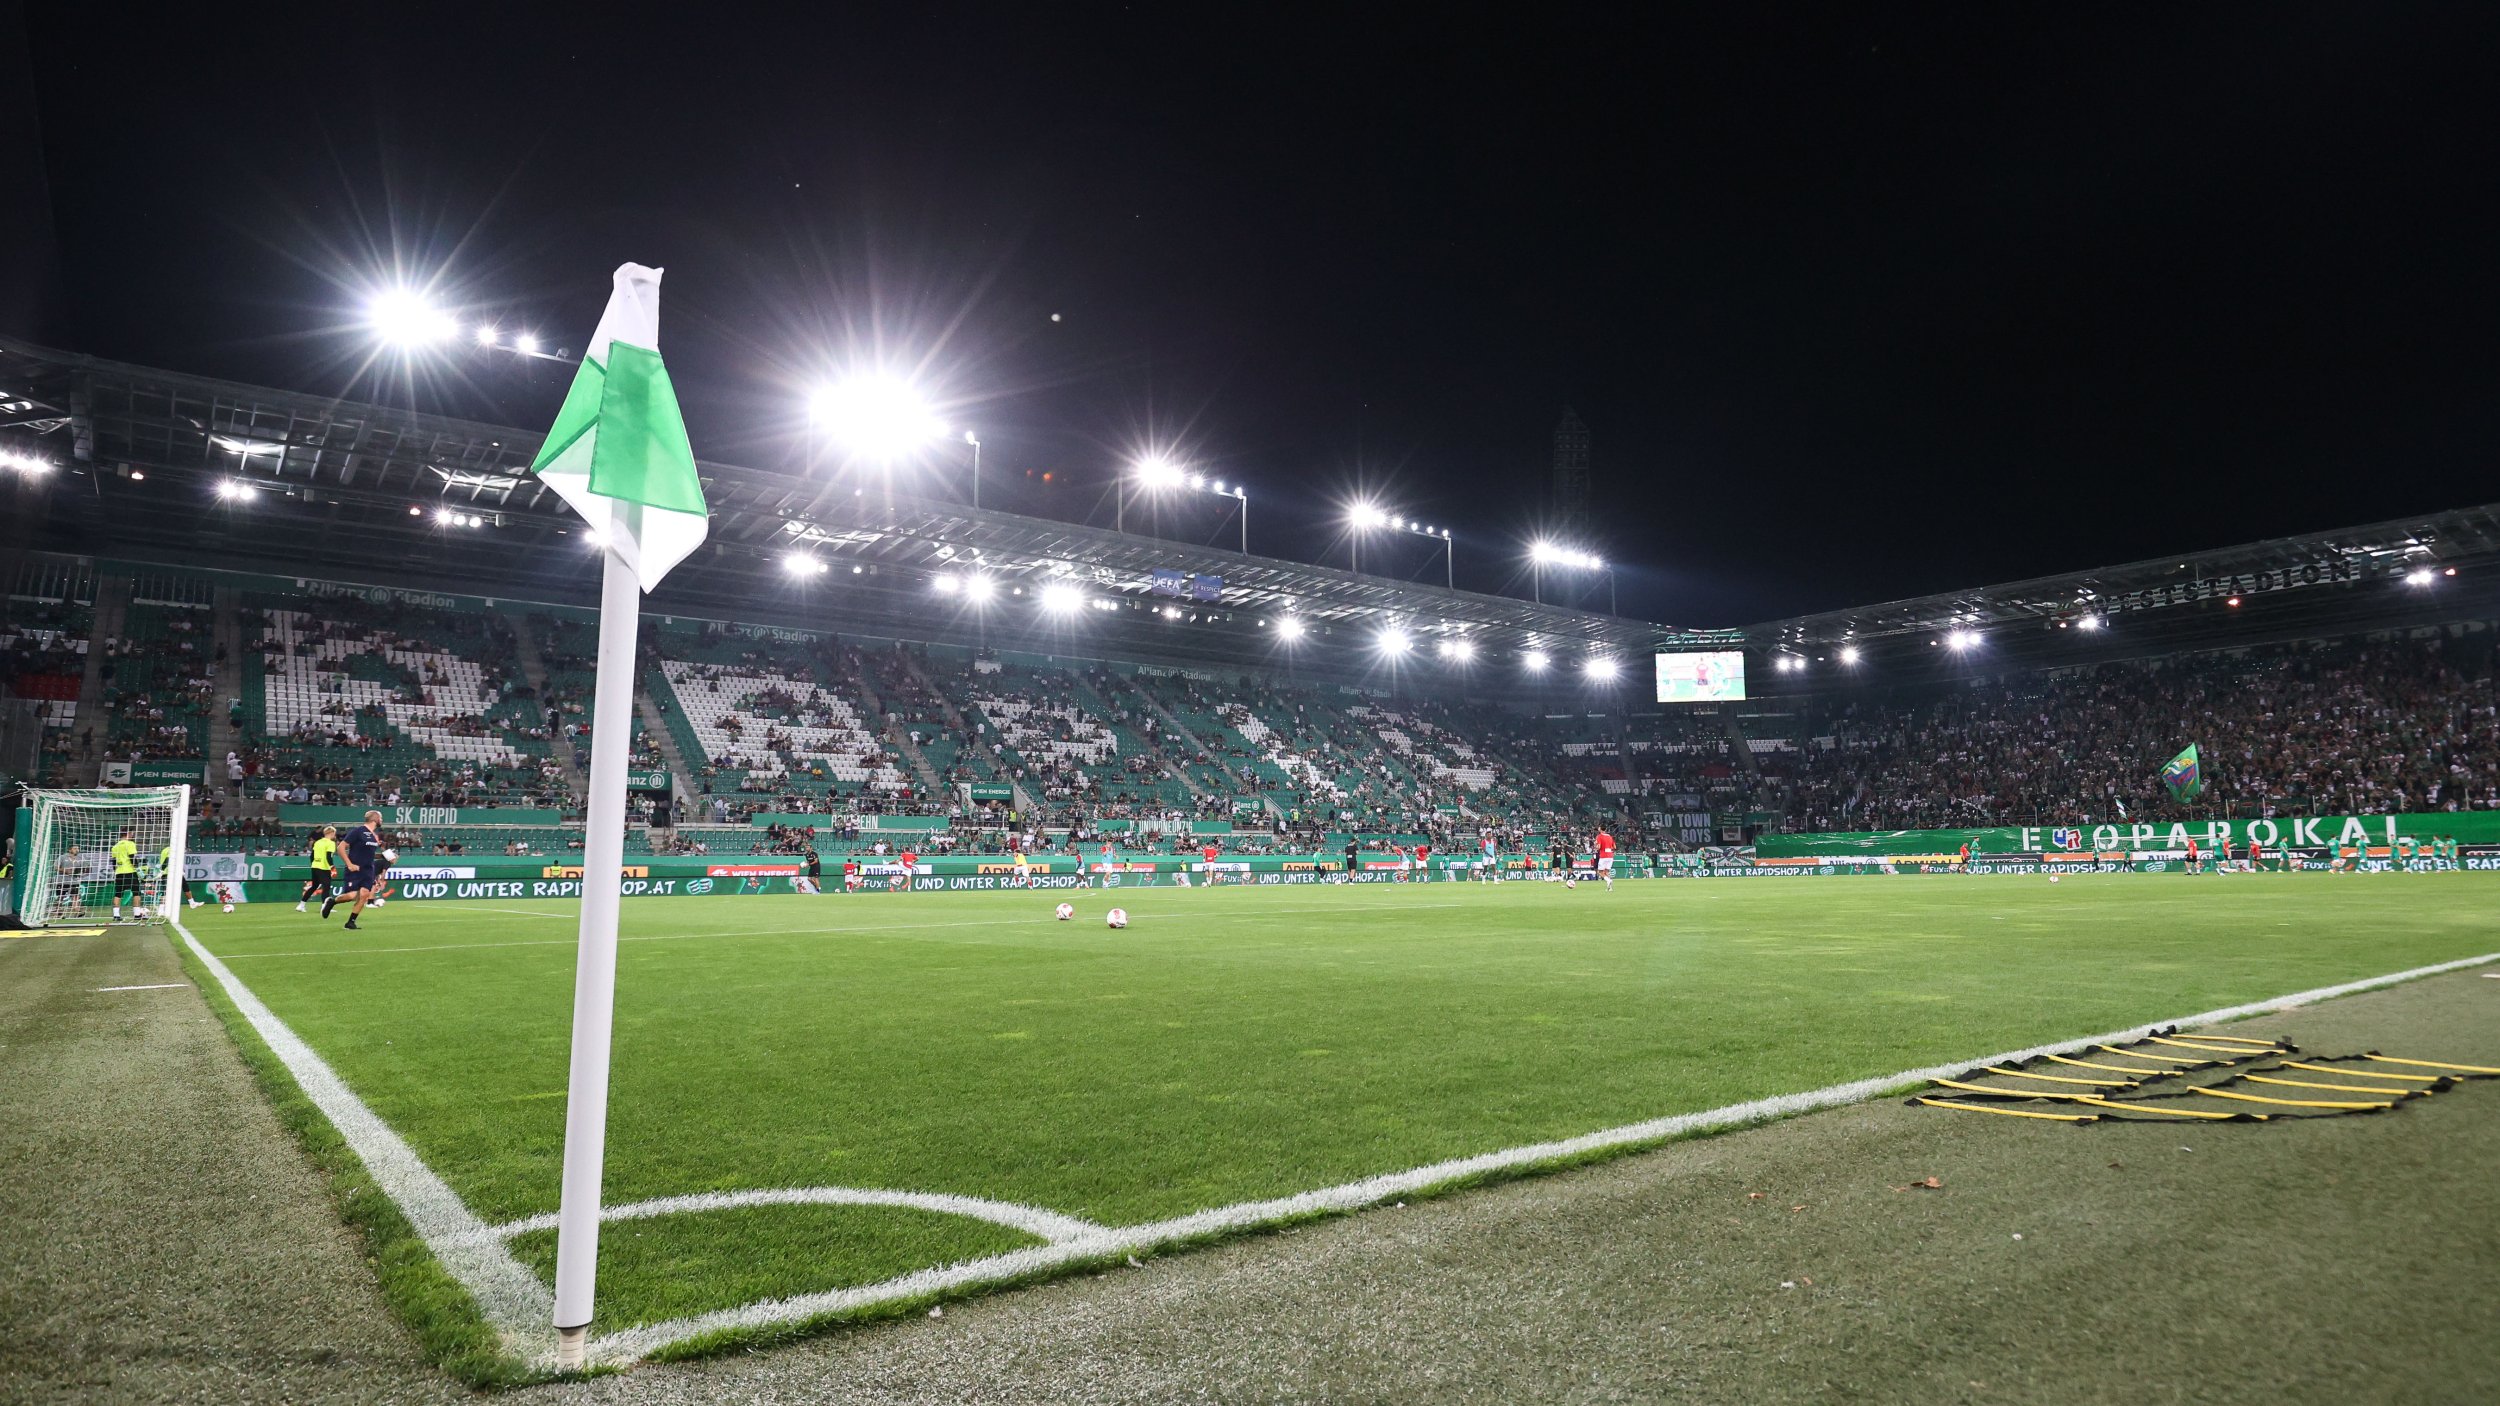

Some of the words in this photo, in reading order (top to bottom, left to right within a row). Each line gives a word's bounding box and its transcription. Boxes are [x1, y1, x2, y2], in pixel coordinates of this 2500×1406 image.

[1152, 576, 1180, 590] UEFA
[1200, 585, 1221, 593] RESPECT
[396, 807, 412, 824] SK
[419, 807, 457, 825] RAPID
[831, 814, 878, 829] AHEHN
[1677, 813, 1711, 828] TOWN
[1681, 828, 1712, 843] BOYS
[387, 868, 432, 880] llianz
[982, 866, 1043, 874] ADMAL
[1506, 870, 1522, 880] UND
[1714, 868, 1742, 876] UNTER
[1746, 867, 1814, 876] RAPIDSHOP.AT
[1997, 864, 2035, 874] UNTER
[915, 877, 945, 890] UND
[950, 877, 994, 889] UNTER
[1000, 875, 1095, 889] RAPDSHOPAT
[1259, 873, 1280, 884] UND
[1284, 873, 1315, 884] UNTER
[1320, 872, 1388, 884] APIDHOP.AT
[403, 883, 448, 898] UND
[457, 881, 523, 898] UNTER
